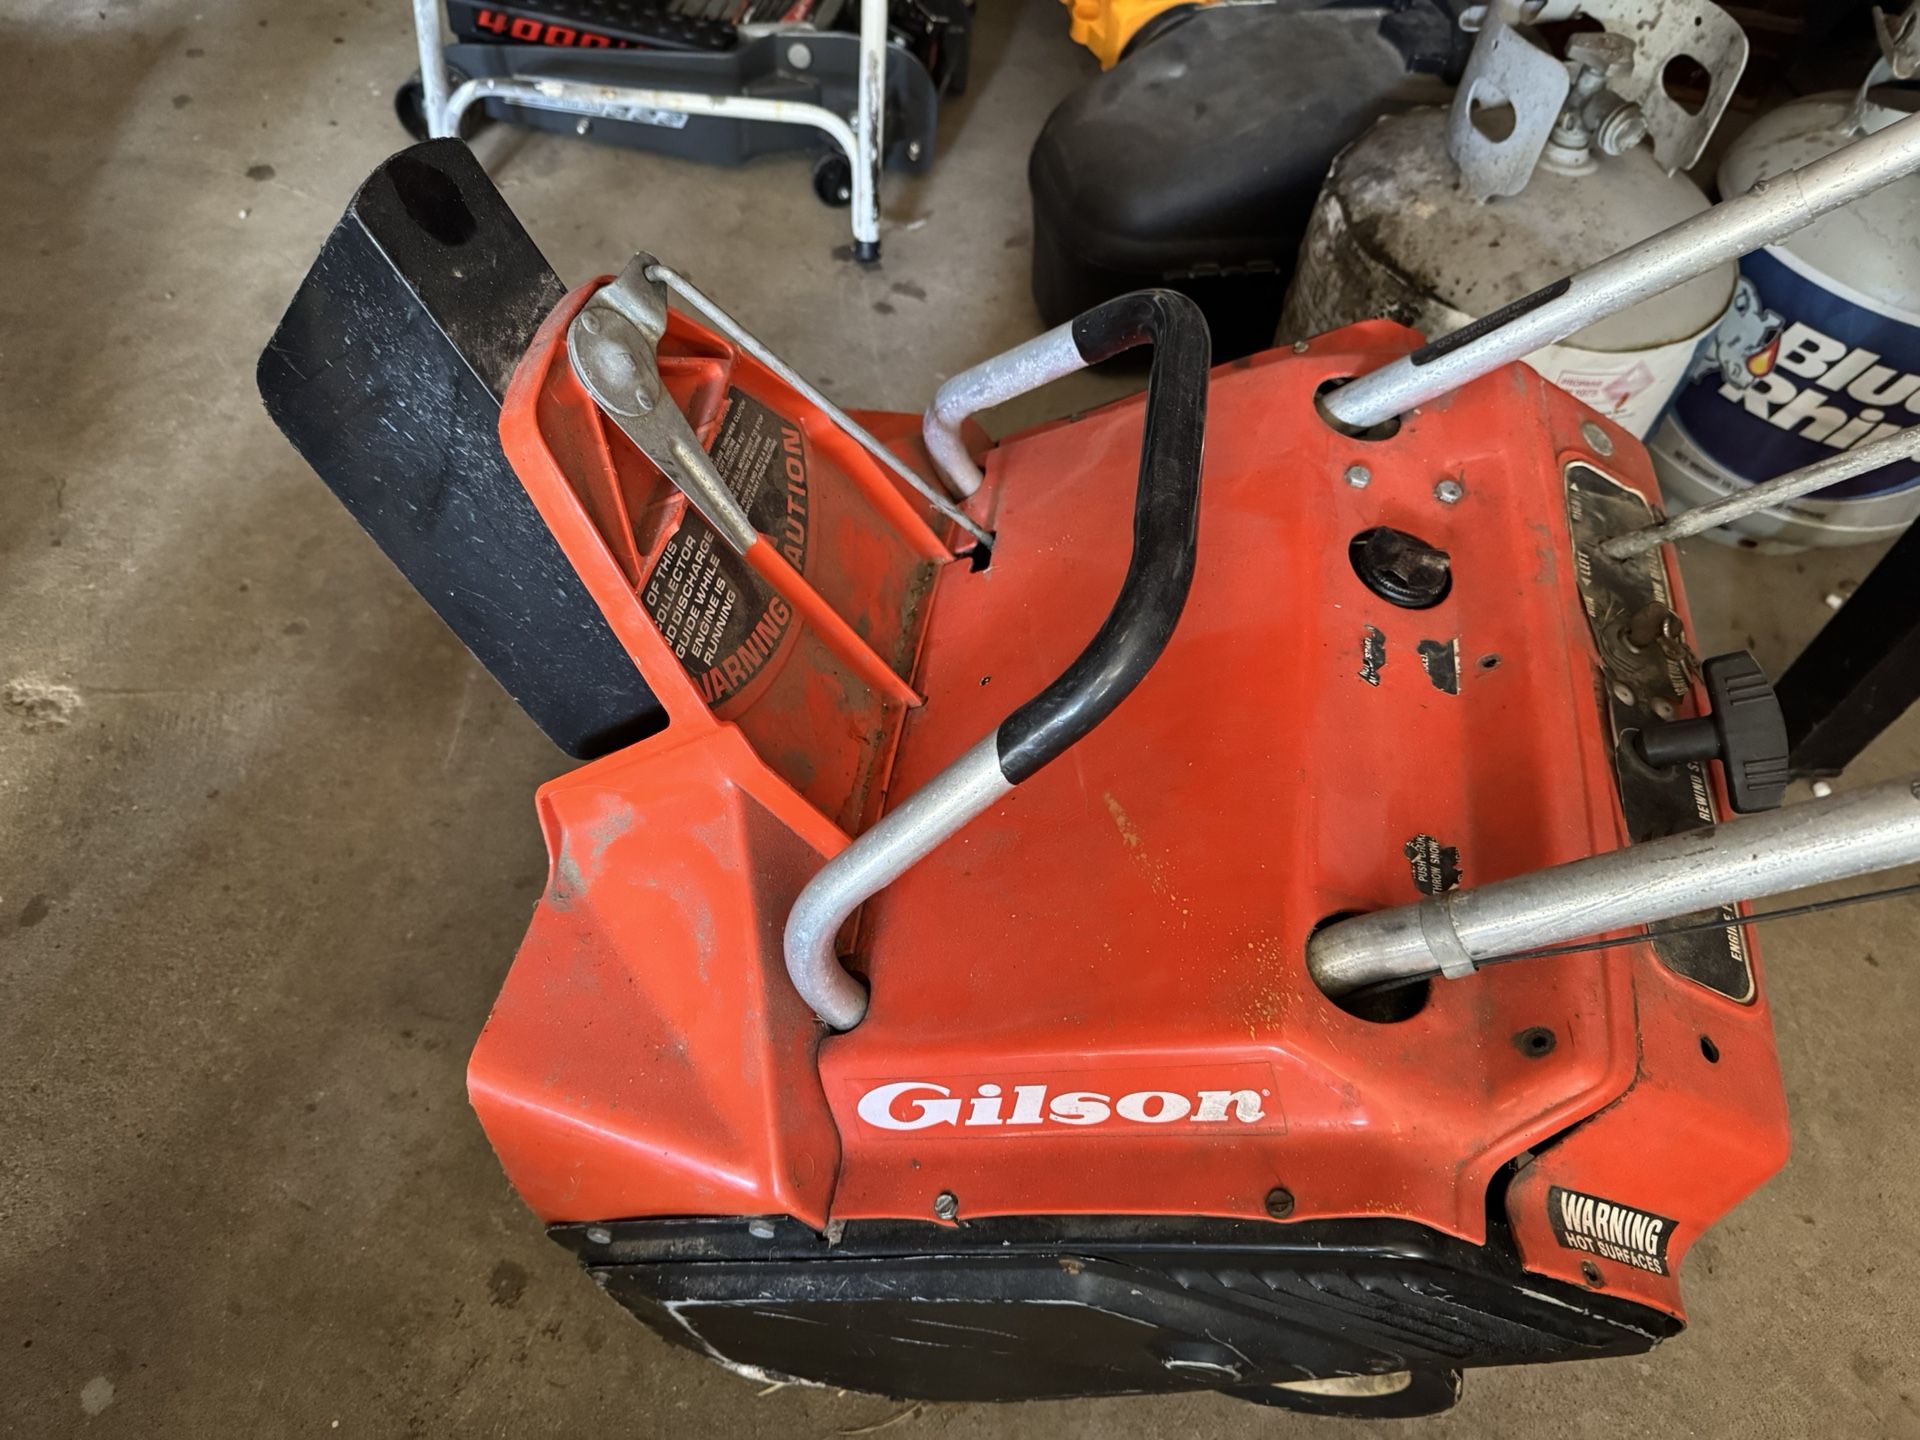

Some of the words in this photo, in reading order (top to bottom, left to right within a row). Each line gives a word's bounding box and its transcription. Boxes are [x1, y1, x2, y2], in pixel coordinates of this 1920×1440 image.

[1718, 373, 1903, 451] Rhi
[782, 427, 807, 571] AUTION
[646, 580, 661, 606] OF
[656, 541, 678, 581] THIS
[671, 530, 715, 627] DISCHARGE
[1578, 552, 1591, 576] LEFT
[675, 605, 701, 660] GUIDE
[695, 553, 721, 605] WHILE
[691, 599, 720, 659] ENGINE
[714, 577, 726, 600] IS
[703, 589, 737, 667] RUNNING
[665, 624, 679, 647] ND
[1691, 775, 1712, 822] REWIND
[1417, 860, 1428, 882] PUSH
[1429, 840, 1440, 865] SNOW
[1431, 866, 1443, 895] THROW
[857, 1081, 1266, 1131] Gilson
[1561, 1191, 1663, 1255] WARNING
[1565, 1231, 1596, 1252] HOT
[1598, 1242, 1663, 1274] SURFACES
